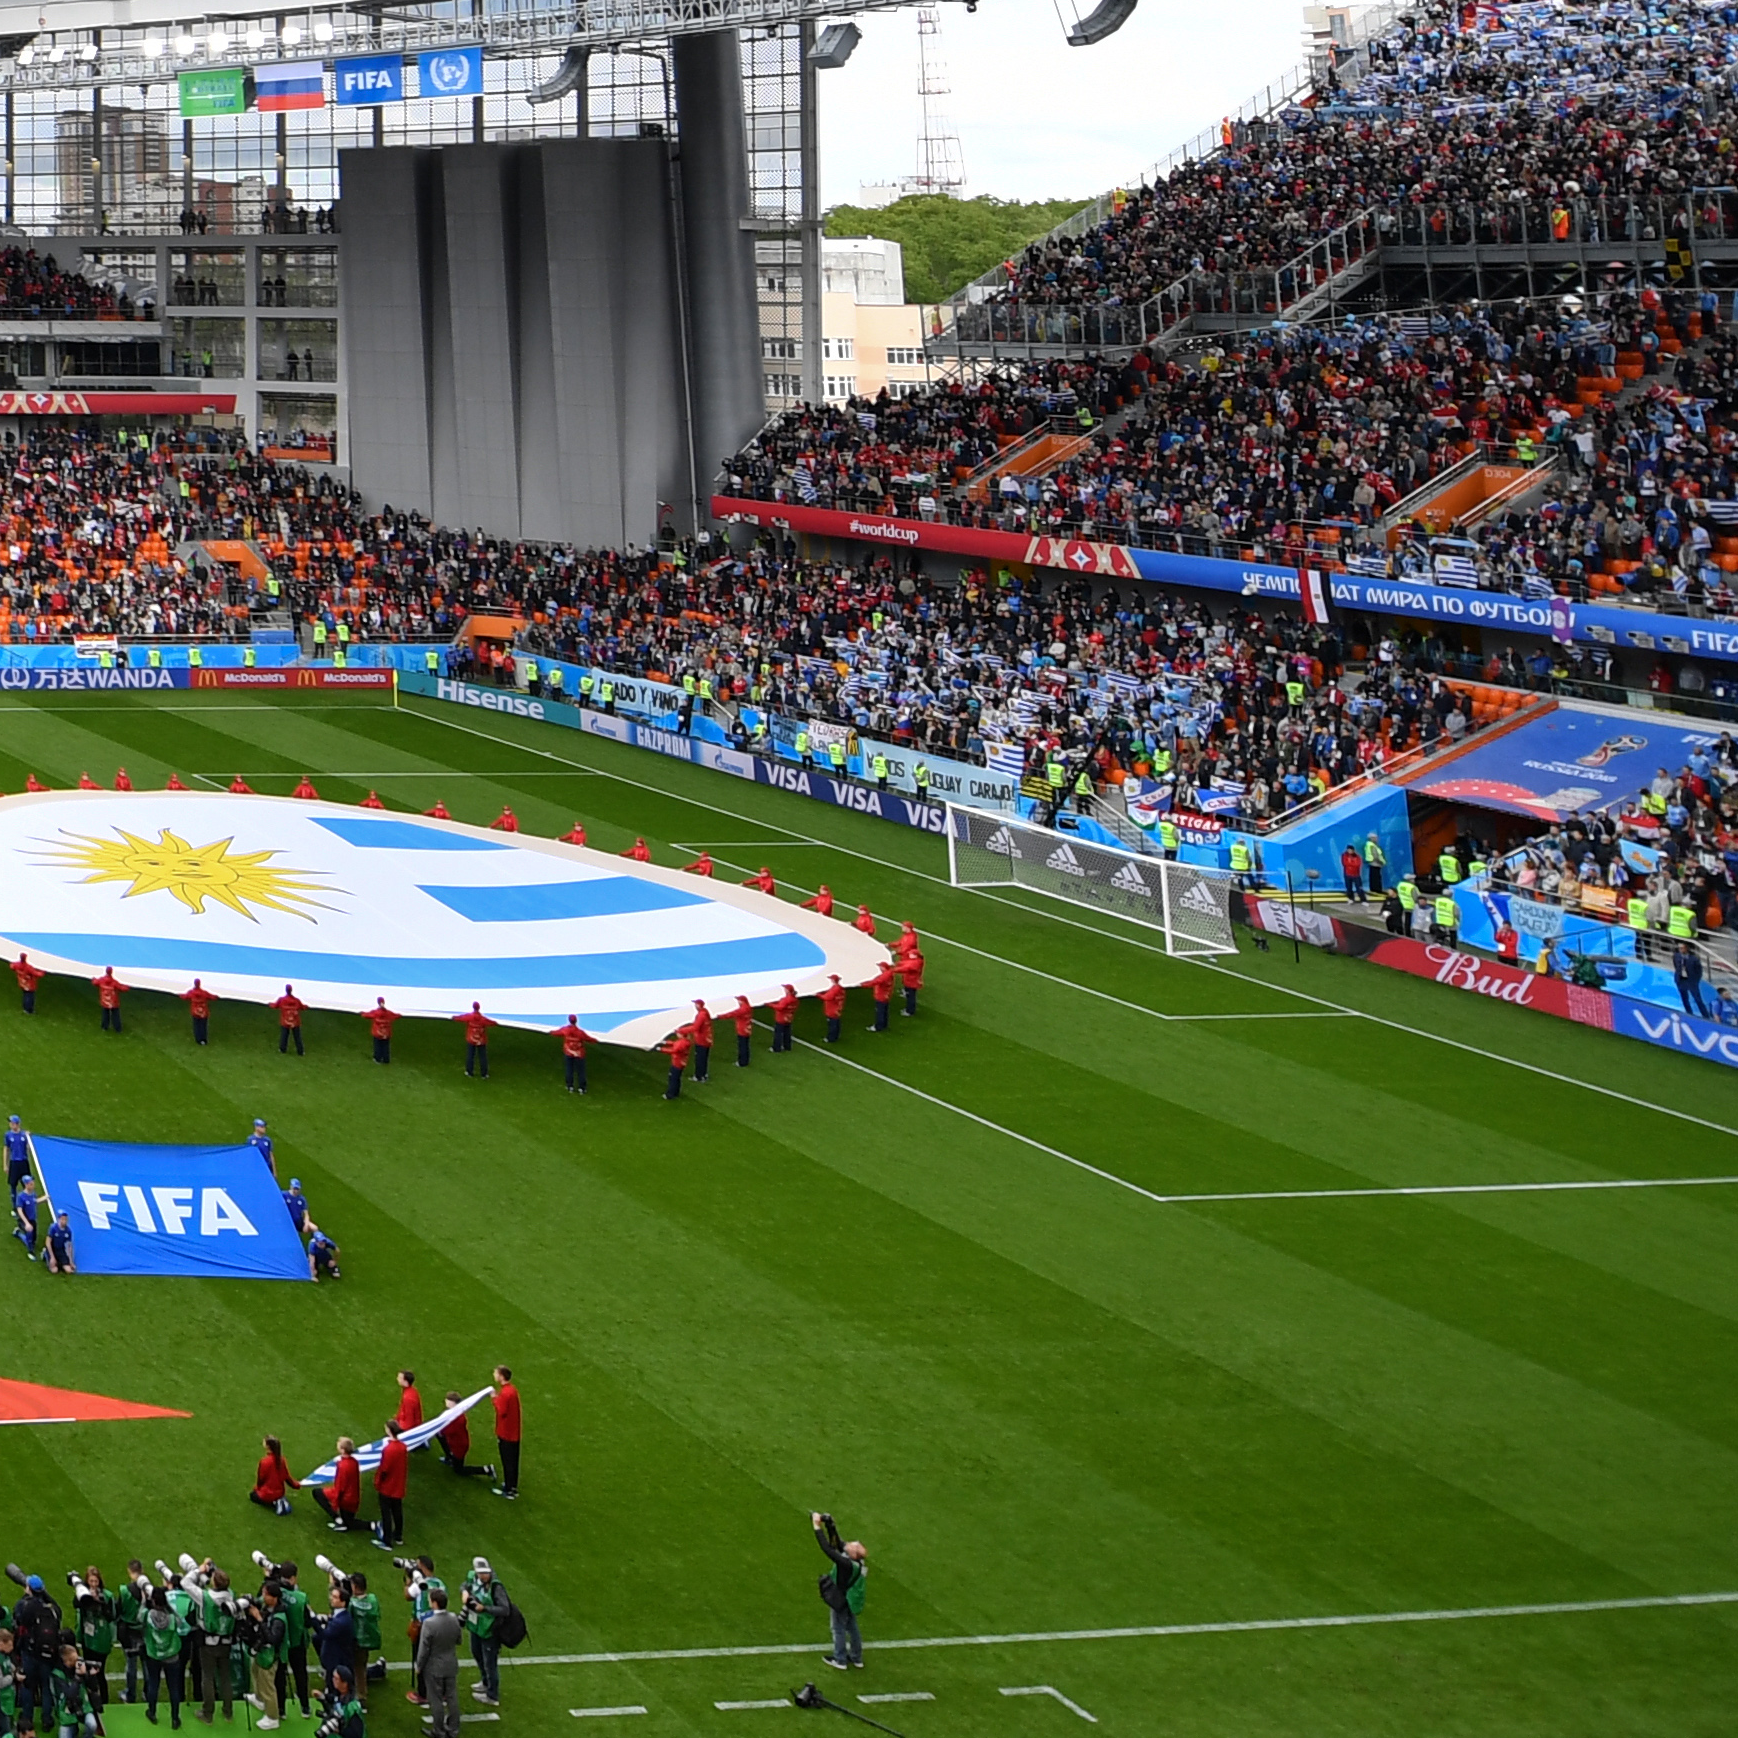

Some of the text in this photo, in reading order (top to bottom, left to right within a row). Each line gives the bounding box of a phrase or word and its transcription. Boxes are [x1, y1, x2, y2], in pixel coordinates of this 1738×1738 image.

[344, 71, 393, 91] FIFA
[850, 519, 919, 545] #worldcup
[1366, 586, 1426, 610] МИРА
[1432, 596, 1464, 615] ПО
[225, 673, 286, 684] McDonald's
[324, 673, 386, 684] McDonald's
[436, 678, 545, 720] Hisense
[649, 688, 677, 711] VINO
[636, 726, 691, 760] GAZPROM
[1681, 734, 1720, 748] FIF
[761, 762, 812, 796] VISA
[828, 778, 883, 816] VISA
[1425, 942, 1535, 1006] Bud
[77, 1180, 260, 1237] FIFA
